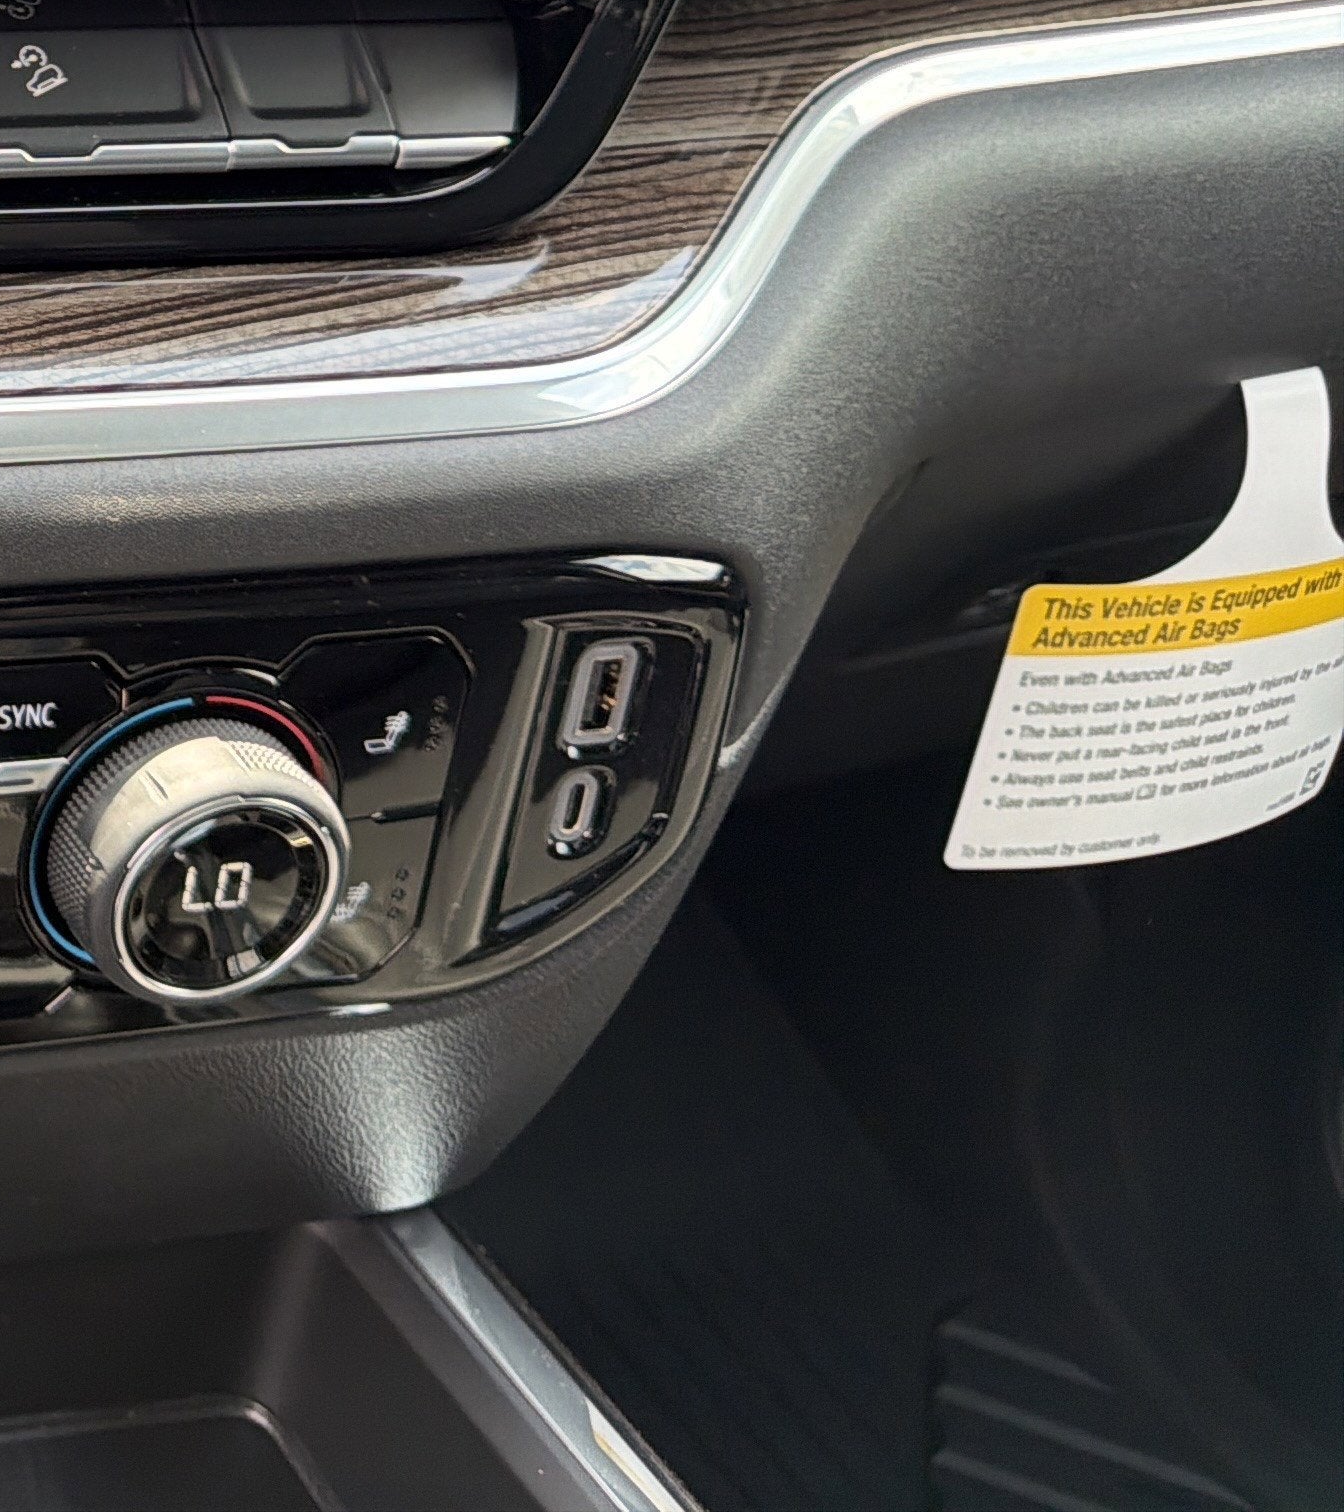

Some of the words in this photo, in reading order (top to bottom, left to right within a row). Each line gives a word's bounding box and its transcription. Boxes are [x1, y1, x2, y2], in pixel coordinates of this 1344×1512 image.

[1043, 596, 1093, 620] This
[1100, 594, 1181, 620] Vehicle
[1186, 591, 1206, 614] is
[1209, 577, 1302, 612] Equipped
[1304, 567, 1343, 595] with
[1032, 623, 1151, 649] Advanced
[1152, 619, 1186, 645] Air
[1189, 617, 1242, 643] Bags
[1019, 670, 1060, 687] Even
[1064, 672, 1098, 685] with
[1101, 665, 1175, 685] Advanced
[1176, 664, 1197, 678] Air
[1199, 660, 1233, 676] Bags
[1025, 700, 1089, 715] Children
